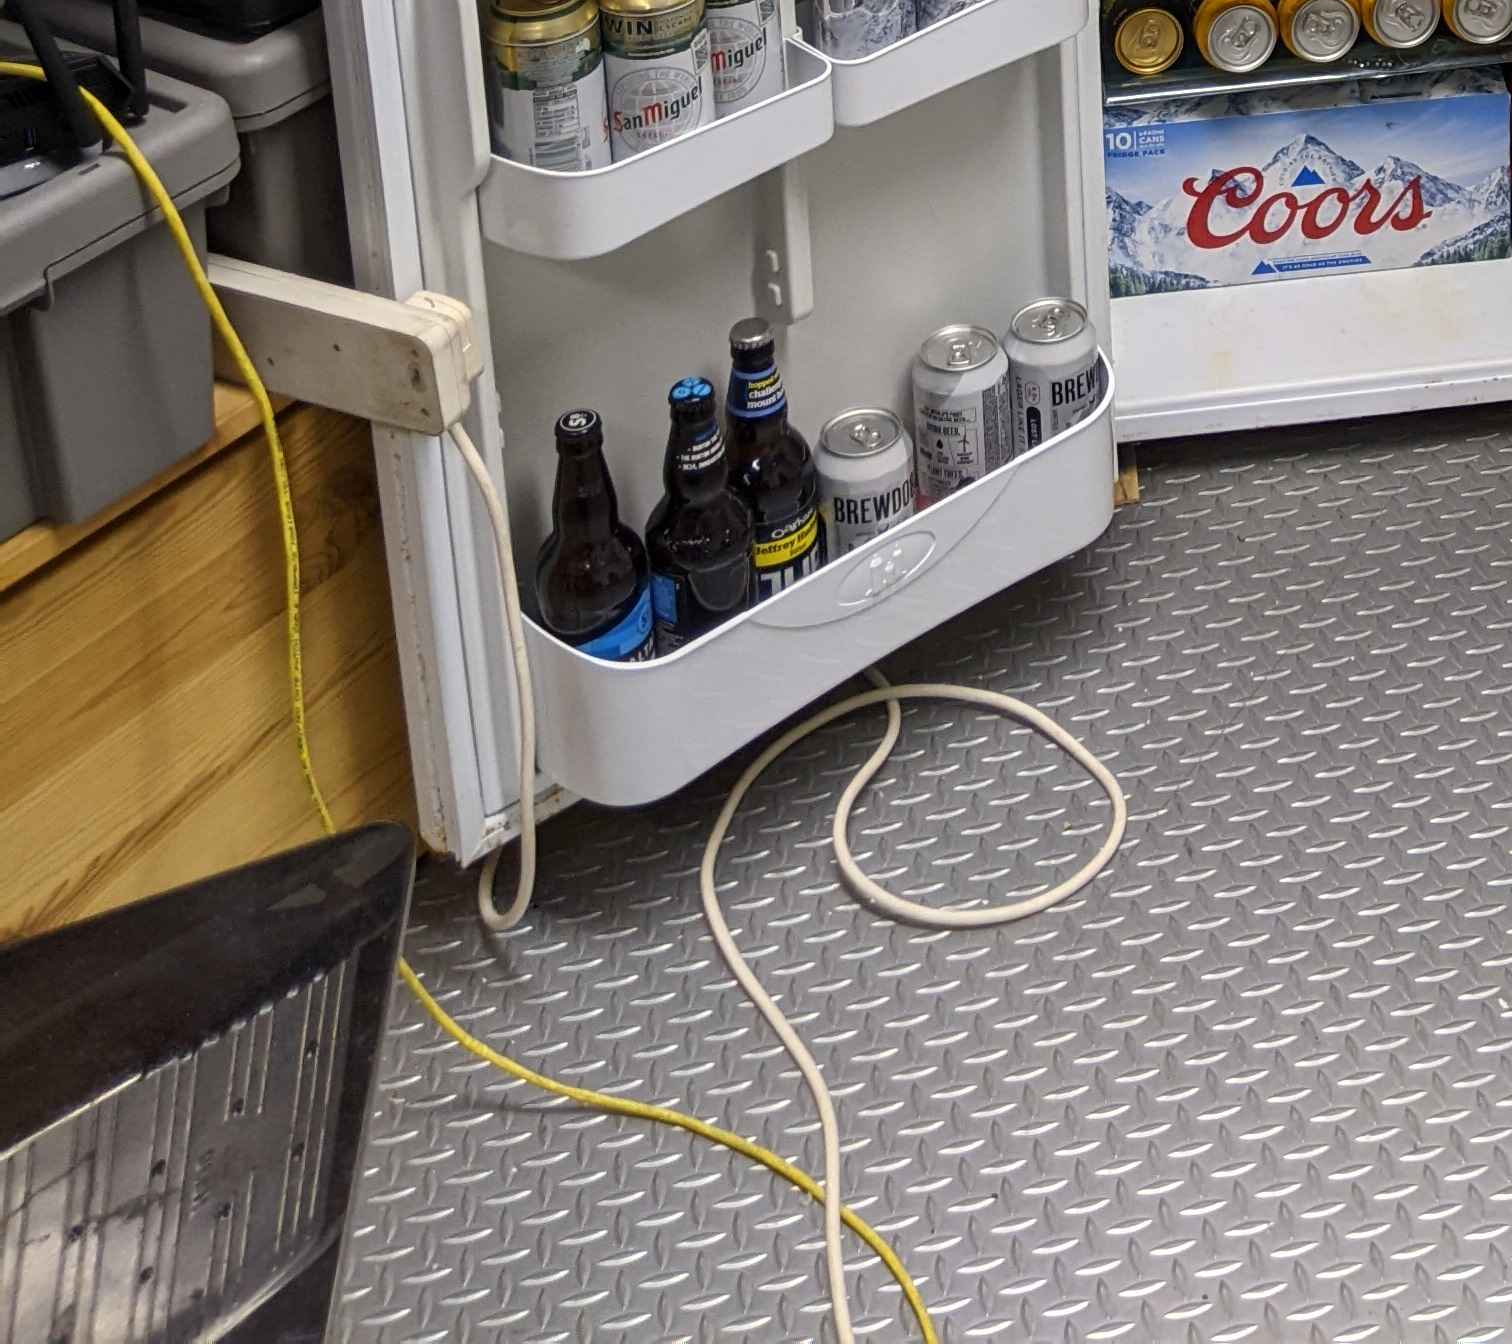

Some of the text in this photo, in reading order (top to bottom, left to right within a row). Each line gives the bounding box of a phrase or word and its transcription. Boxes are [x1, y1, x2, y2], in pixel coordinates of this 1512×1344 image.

[604, 16, 654, 36] WIN
[1105, 132, 1133, 152] 10
[1182, 166, 1434, 250] Coors
